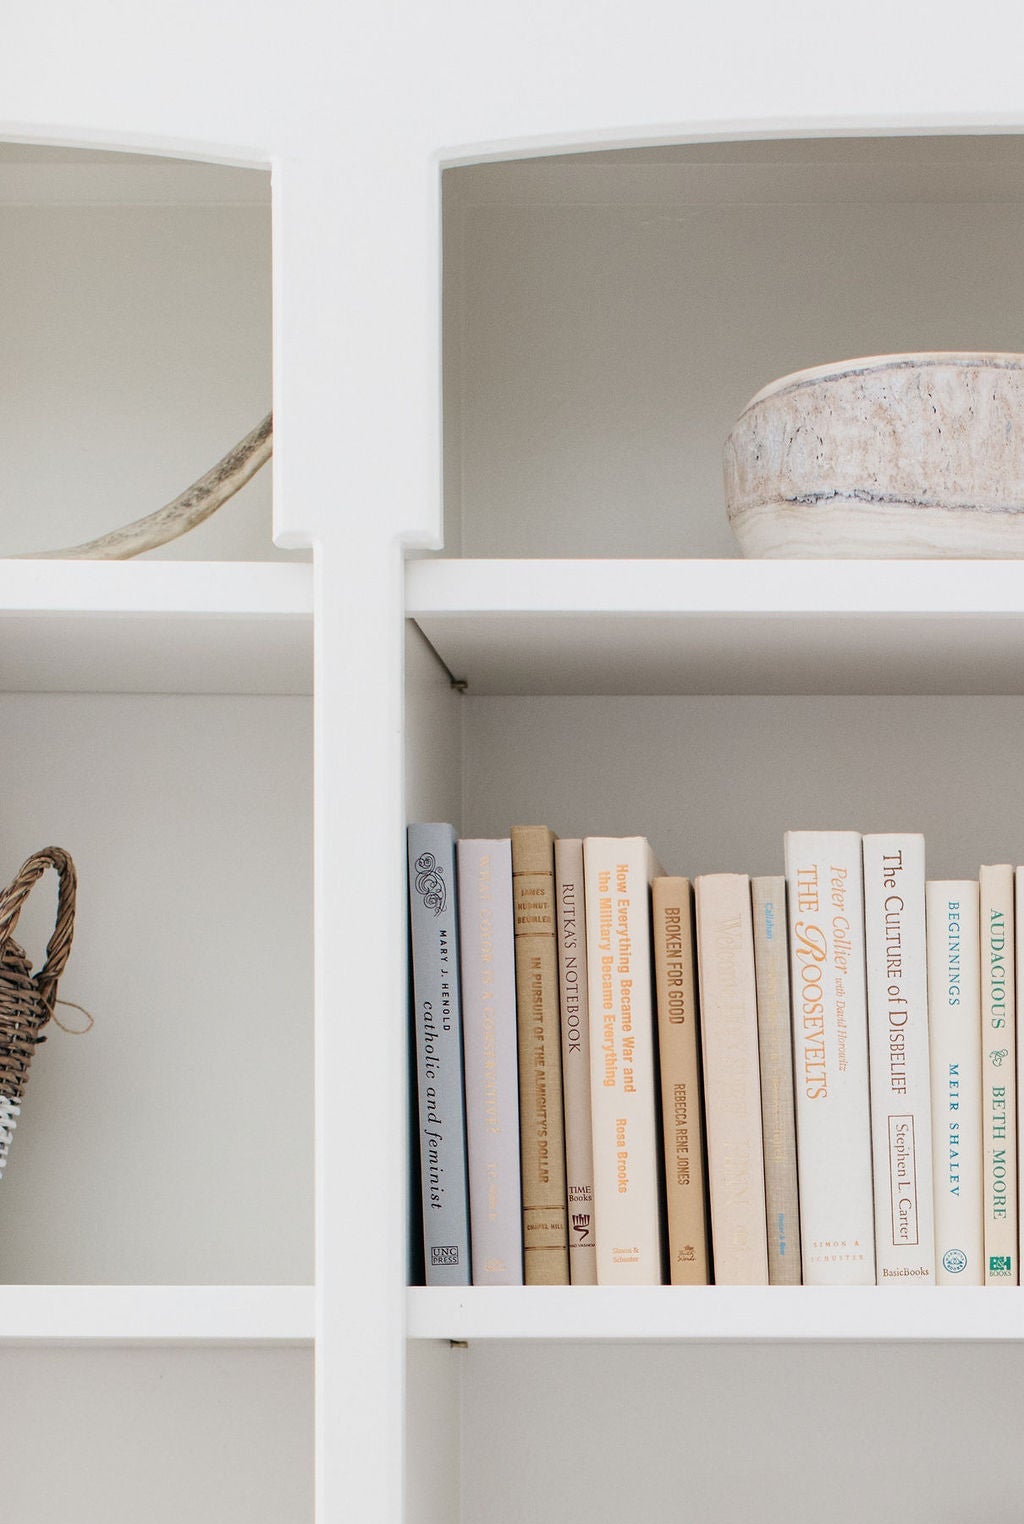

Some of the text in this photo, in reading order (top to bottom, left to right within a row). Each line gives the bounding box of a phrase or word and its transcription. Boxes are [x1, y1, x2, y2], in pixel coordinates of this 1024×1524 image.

[480, 908, 494, 961] COLOR
[830, 866, 849, 910] Peter
[439, 930, 451, 1032] MARY J. HENOLD
[482, 969, 495, 984] IS
[482, 991, 495, 1000] A
[562, 883, 581, 1053] RUTKA'S NOTEBOOK
[597, 871, 618, 1087] the Military Became Everything
[614, 864, 637, 1093] How Everything Became War and
[665, 907, 685, 1024] BROKEN FOR GOOD
[795, 864, 829, 1100] THE ROOSEVELTS
[831, 916, 851, 975] Collier
[834, 977, 846, 997] with
[881, 850, 909, 1095] The CULTURE of DISBELIEF
[947, 901, 961, 1006] BEGINNINGS
[990, 908, 1005, 1029] AUDACIOUS
[835, 1000, 848, 1026] David
[423, 1001, 444, 1209] catholic and feminist
[531, 957, 549, 1183] IN PURSUIT OF THE ALMIGHTY'S DOLLAR
[616, 1118, 630, 1193] Rosa Brooks
[674, 1084, 690, 1186] REBECCA RENE JONES
[893, 1123, 912, 1240] Stephen L. Carter
[949, 1063, 961, 1198] MEIR SHALEV
[992, 1086, 1007, 1220] BETH MOORE
[569, 1194, 593, 1202] Books
[570, 1186, 592, 1194] TIME
[433, 1248, 457, 1256] UNC
[882, 1267, 929, 1277] BasicBooks
